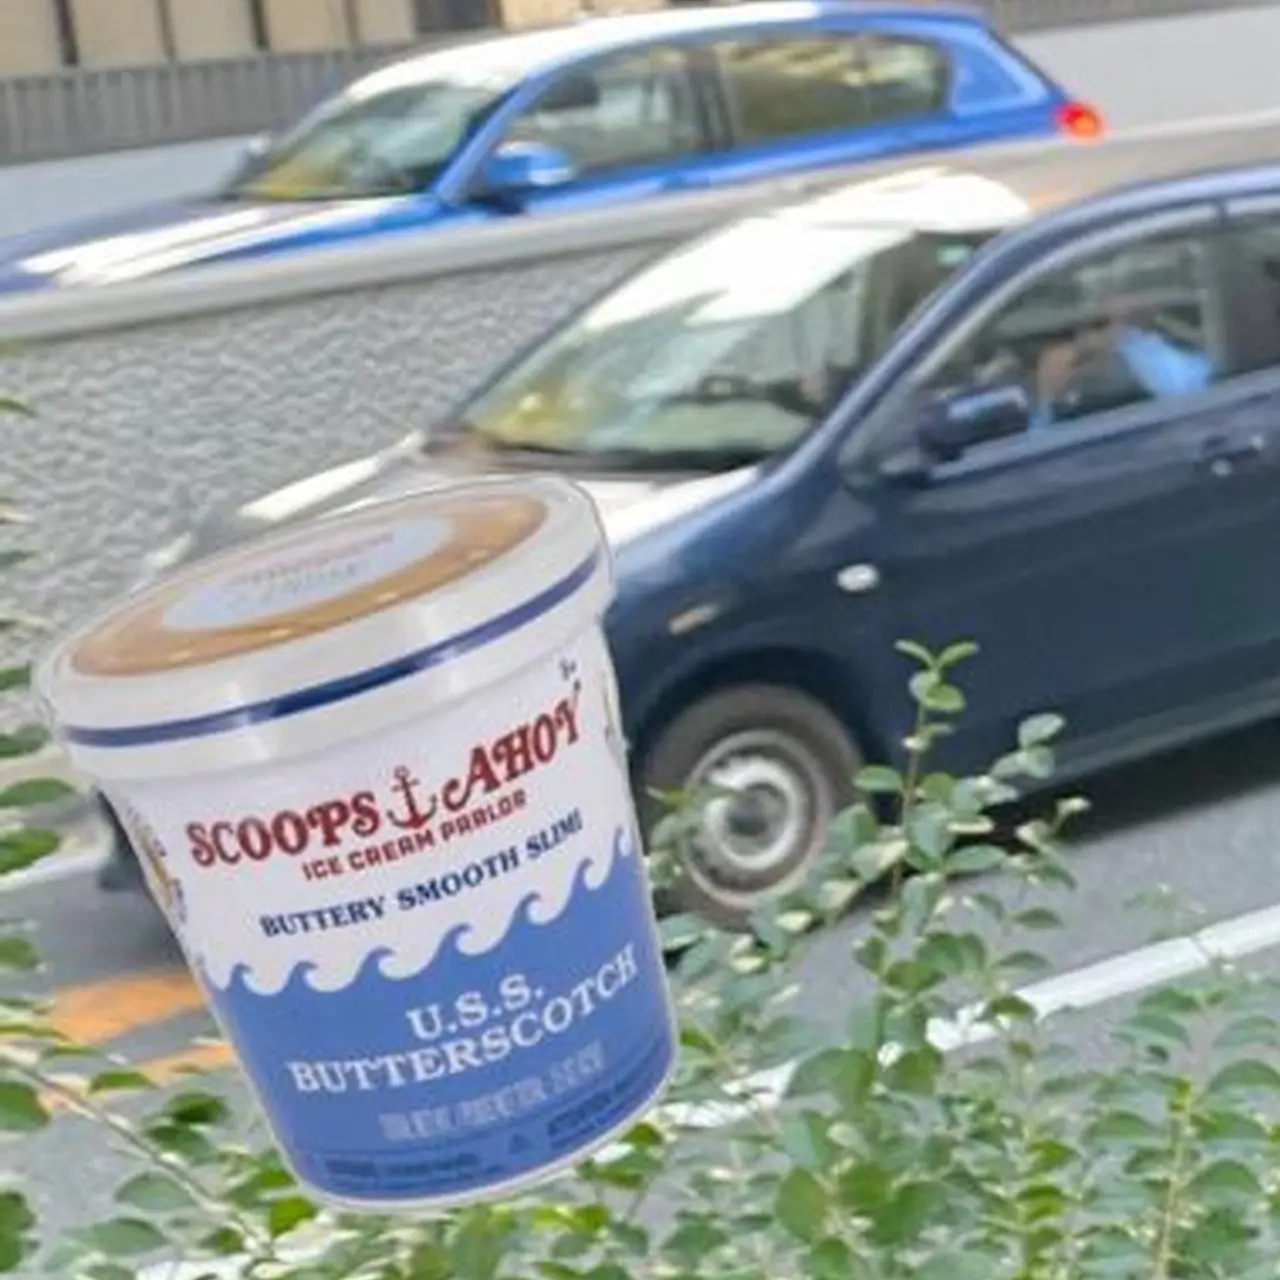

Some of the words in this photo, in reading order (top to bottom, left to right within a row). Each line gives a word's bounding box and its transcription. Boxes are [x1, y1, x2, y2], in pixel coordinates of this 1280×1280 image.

[186, 791, 380, 867] SCOOPS
[442, 681, 581, 812] AHOY
[303, 861, 343, 880] ICE
[349, 832, 435, 871] CREAM
[442, 788, 527, 841] PARLOR
[259, 896, 385, 938] BUTTERY
[396, 851, 520, 911] SMOOTH
[286, 942, 639, 1092] BUTTERSCOTCH
[406, 974, 544, 1040] U.S.S.
